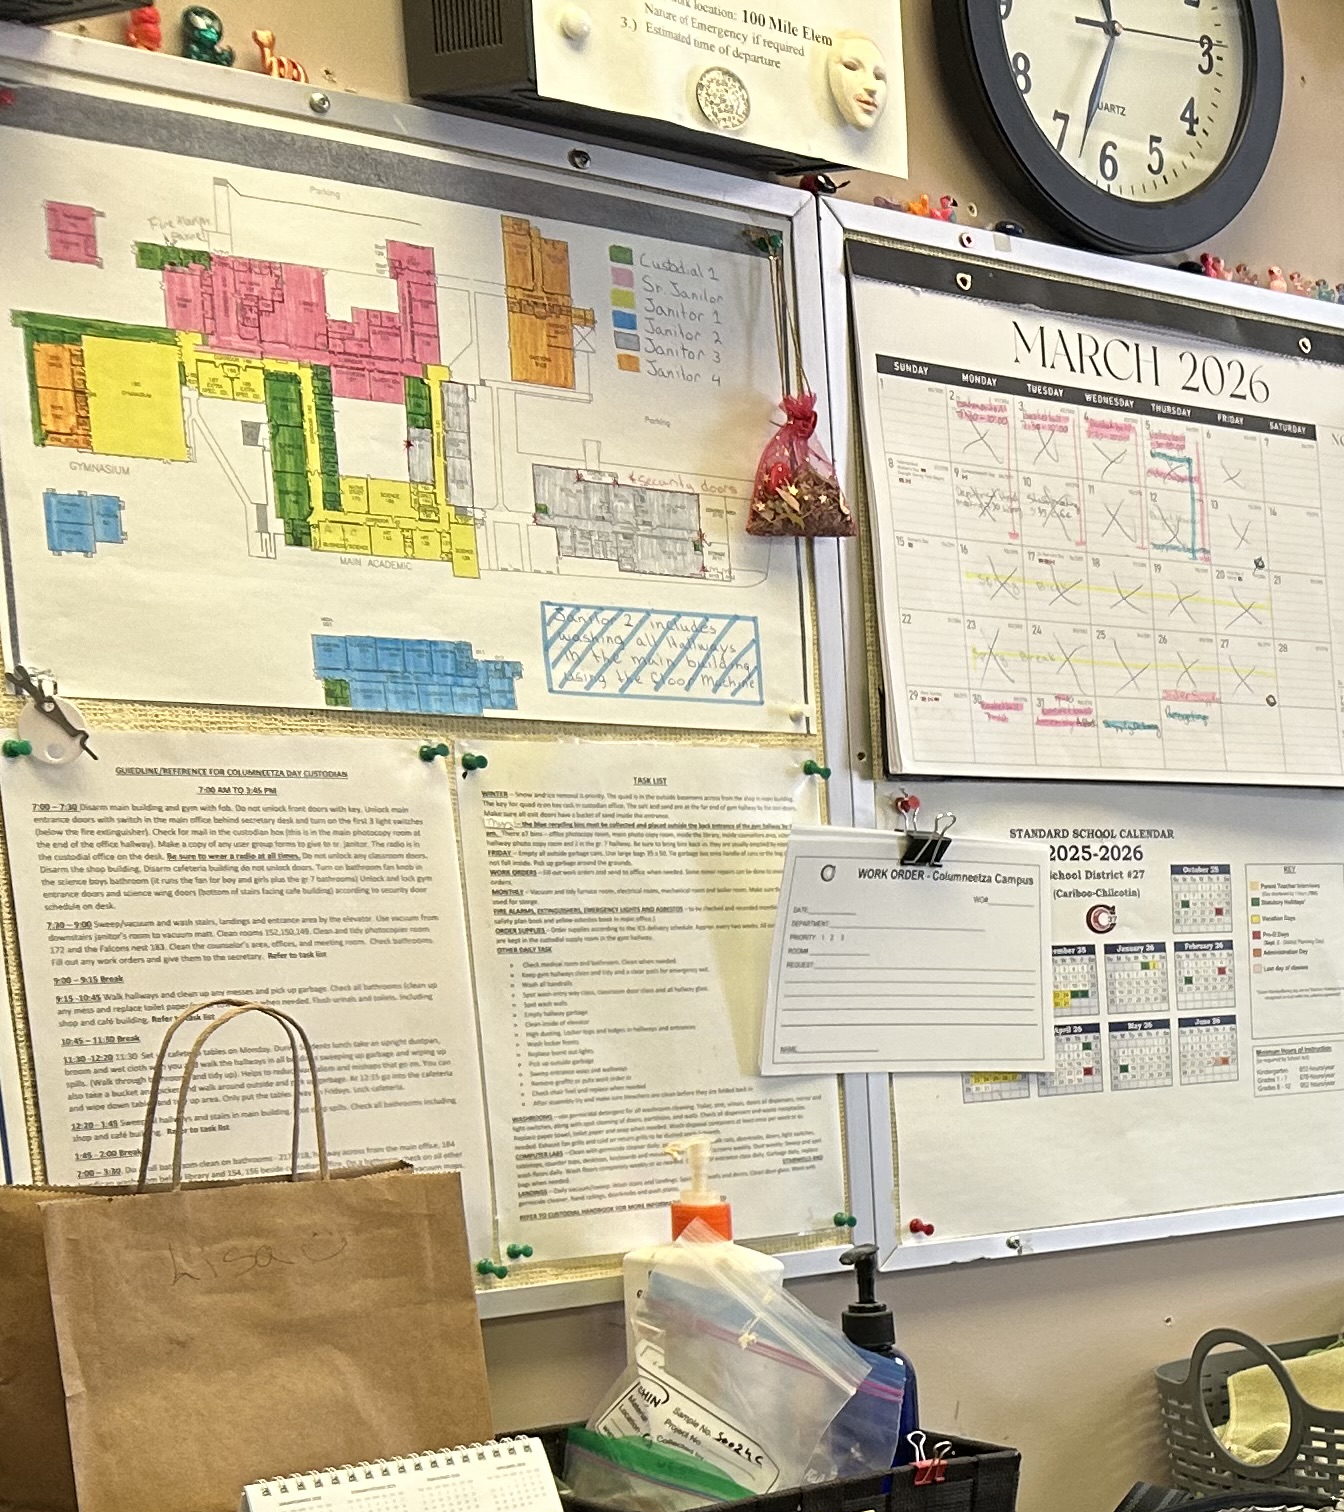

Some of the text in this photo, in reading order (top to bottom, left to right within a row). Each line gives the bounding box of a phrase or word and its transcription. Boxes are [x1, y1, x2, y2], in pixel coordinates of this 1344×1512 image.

[645, 2, 805, 57] Nature of Emergency if required
[743, 10, 766, 27] 100
[769, 16, 799, 37] Mile
[803, 26, 833, 47] Elem
[620, 16, 781, 69] 3.) Estimated time of departure
[1198, 35, 1214, 74] 3
[1012, 52, 1032, 94] 8
[1097, 101, 1126, 117] UARTZ
[1180, 97, 1199, 136] 4
[1052, 109, 1070, 152] 7
[1099, 141, 1118, 181] 6
[1147, 134, 1164, 175] 5
[640, 253, 704, 278] Custodial
[642, 275, 723, 303] Sr. Janitor
[644, 298, 722, 324] Janitor 1
[644, 317, 722, 344] Janitor 2
[645, 337, 721, 363] Janitor 3
[1012, 321, 1271, 404] MARCH 2026
[646, 360, 721, 386] Janitor 4
[893, 361, 1307, 435] SUNDAY MONDAY TUESDAY WEDNESDAY THURSDAY FRIDAY SATURDAY
[69, 461, 130, 475] GYMNASIUM
[339, 556, 412, 570] MAIN ACADEMIC
[624, 614, 633, 627] 2
[592, 651, 622, 664] the
[209, 769, 225, 777] FOR
[286, 770, 301, 778] DAY
[303, 770, 348, 779] CUSTODIAN
[633, 777, 667, 785] TASK LIST
[1010, 829, 1174, 840] STANDARD SCHOOL CALENDAR
[1050, 845, 1144, 861] 2025-2026
[858, 868, 1034, 886] WORK ORDER Columneetza Campus
[1085, 870, 1123, 880] District
[1127, 870, 1145, 880] #27
[1053, 889, 1141, 900] (Cariboo-Chilcotin)
[664, 1418, 689, 1440] Project
[672, 1406, 711, 1437] Sample No.
